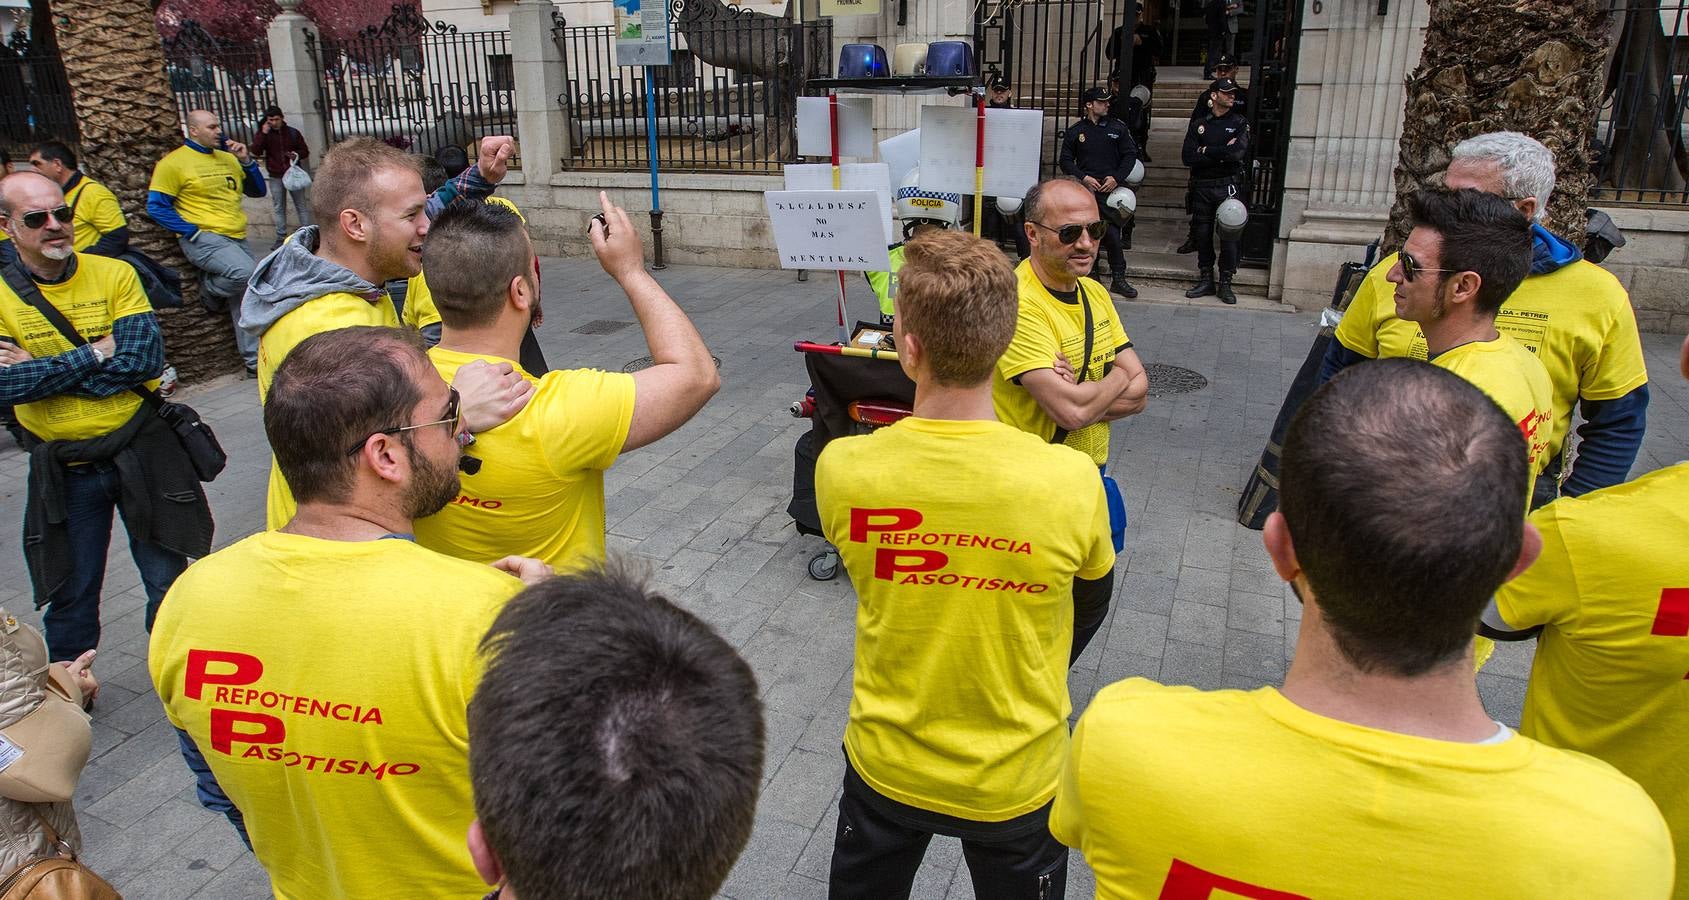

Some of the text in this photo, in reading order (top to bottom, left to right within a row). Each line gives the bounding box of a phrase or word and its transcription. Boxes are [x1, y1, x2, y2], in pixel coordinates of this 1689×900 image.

[911, 198, 942, 207] POLICIA
[1520, 311, 1549, 319] PETRER
[850, 507, 1032, 555] PREPOTENCIA
[875, 547, 1049, 594] PASOTISMO
[184, 648, 383, 725] PREPOTENCIA
[211, 708, 421, 781] PASOTISMO
